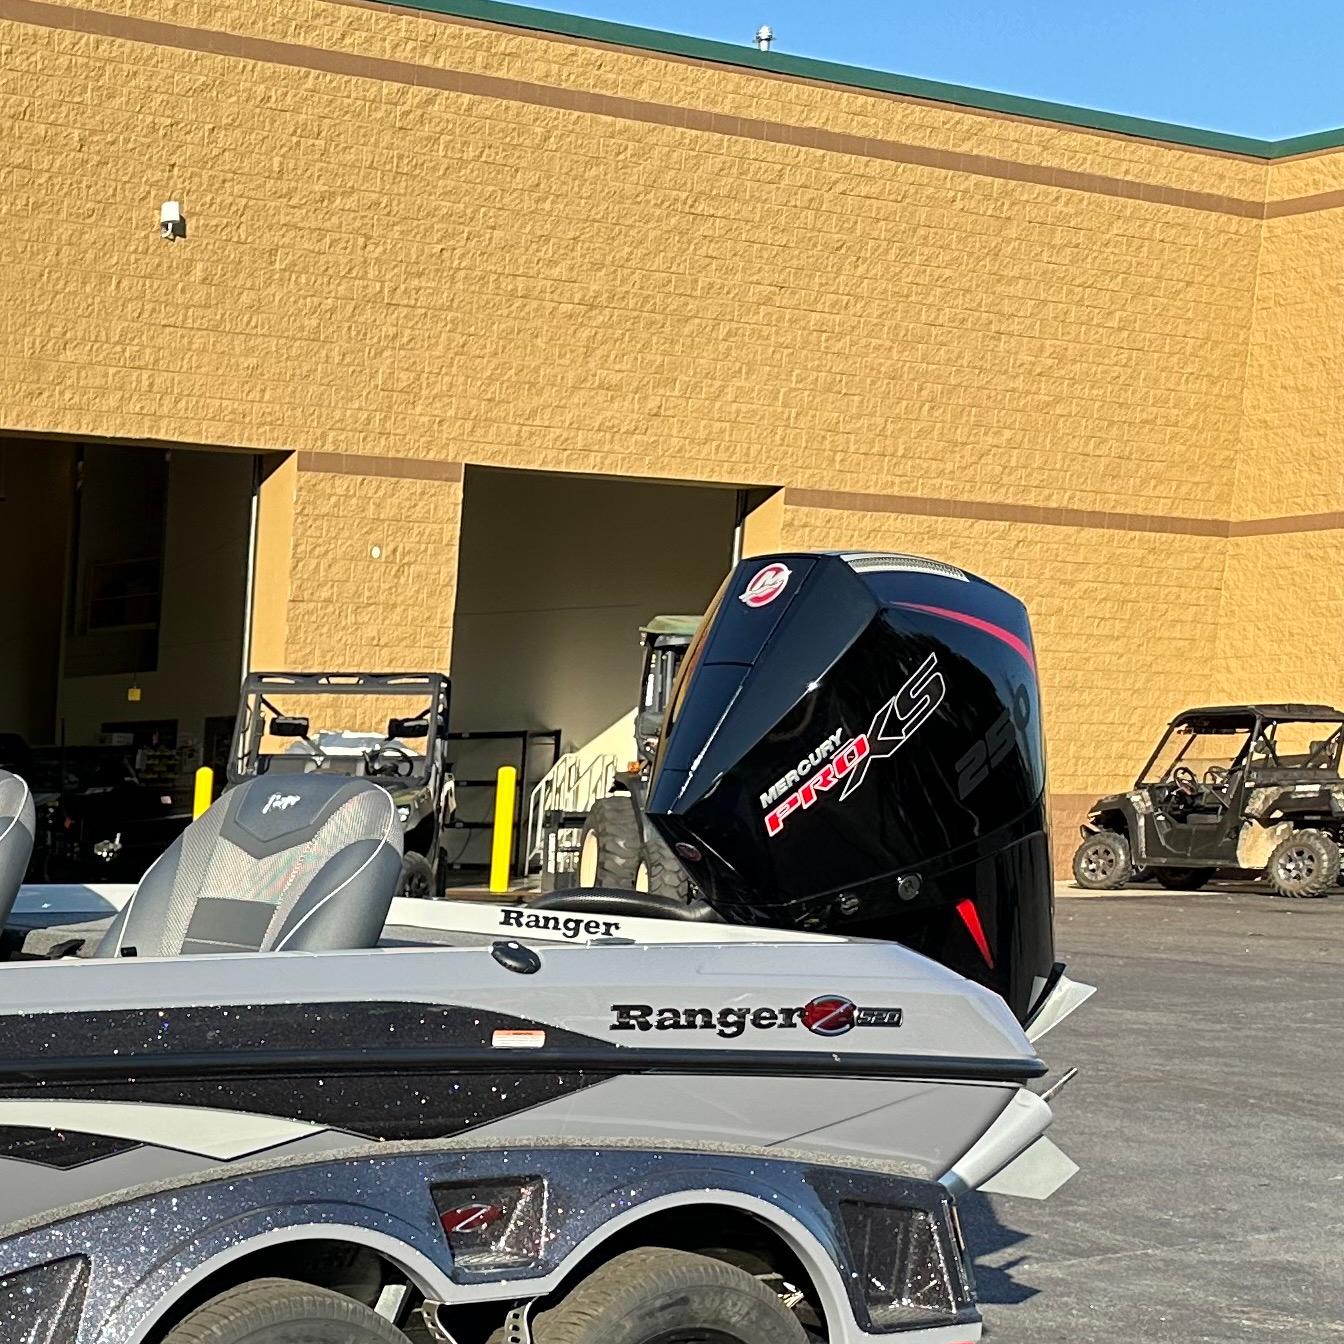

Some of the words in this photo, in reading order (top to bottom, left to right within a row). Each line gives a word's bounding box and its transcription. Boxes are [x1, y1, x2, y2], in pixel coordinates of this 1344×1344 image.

[759, 727, 843, 808] MERCURY
[954, 684, 1031, 800] 250
[764, 733, 870, 837] PRO
[499, 909, 620, 938] Ranger
[609, 1004, 805, 1038] Ranger
